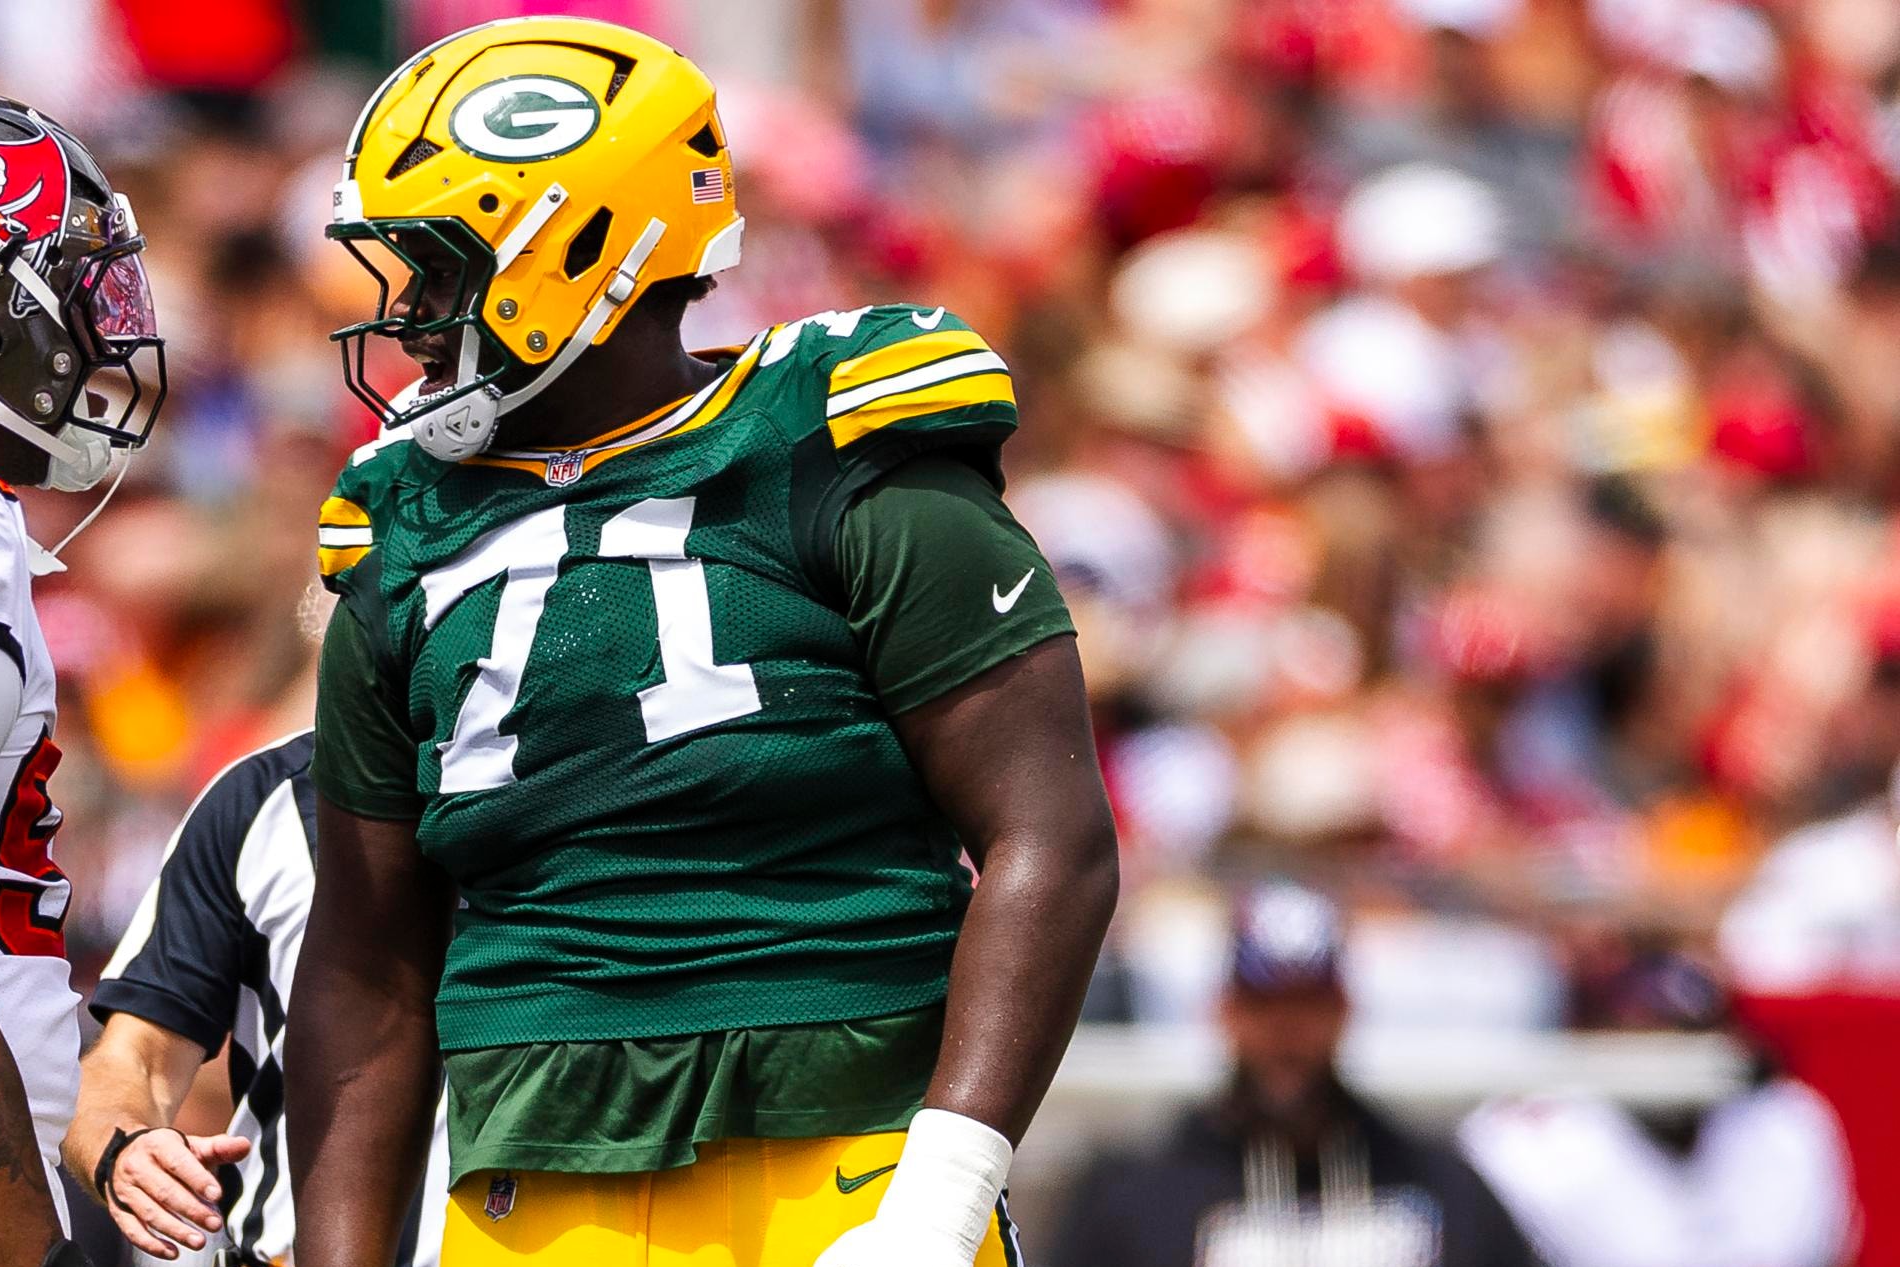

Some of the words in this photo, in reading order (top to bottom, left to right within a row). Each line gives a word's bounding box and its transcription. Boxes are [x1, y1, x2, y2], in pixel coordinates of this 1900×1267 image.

[449, 74, 602, 163] G
[551, 463, 576, 481] NFL
[420, 496, 762, 794] 71
